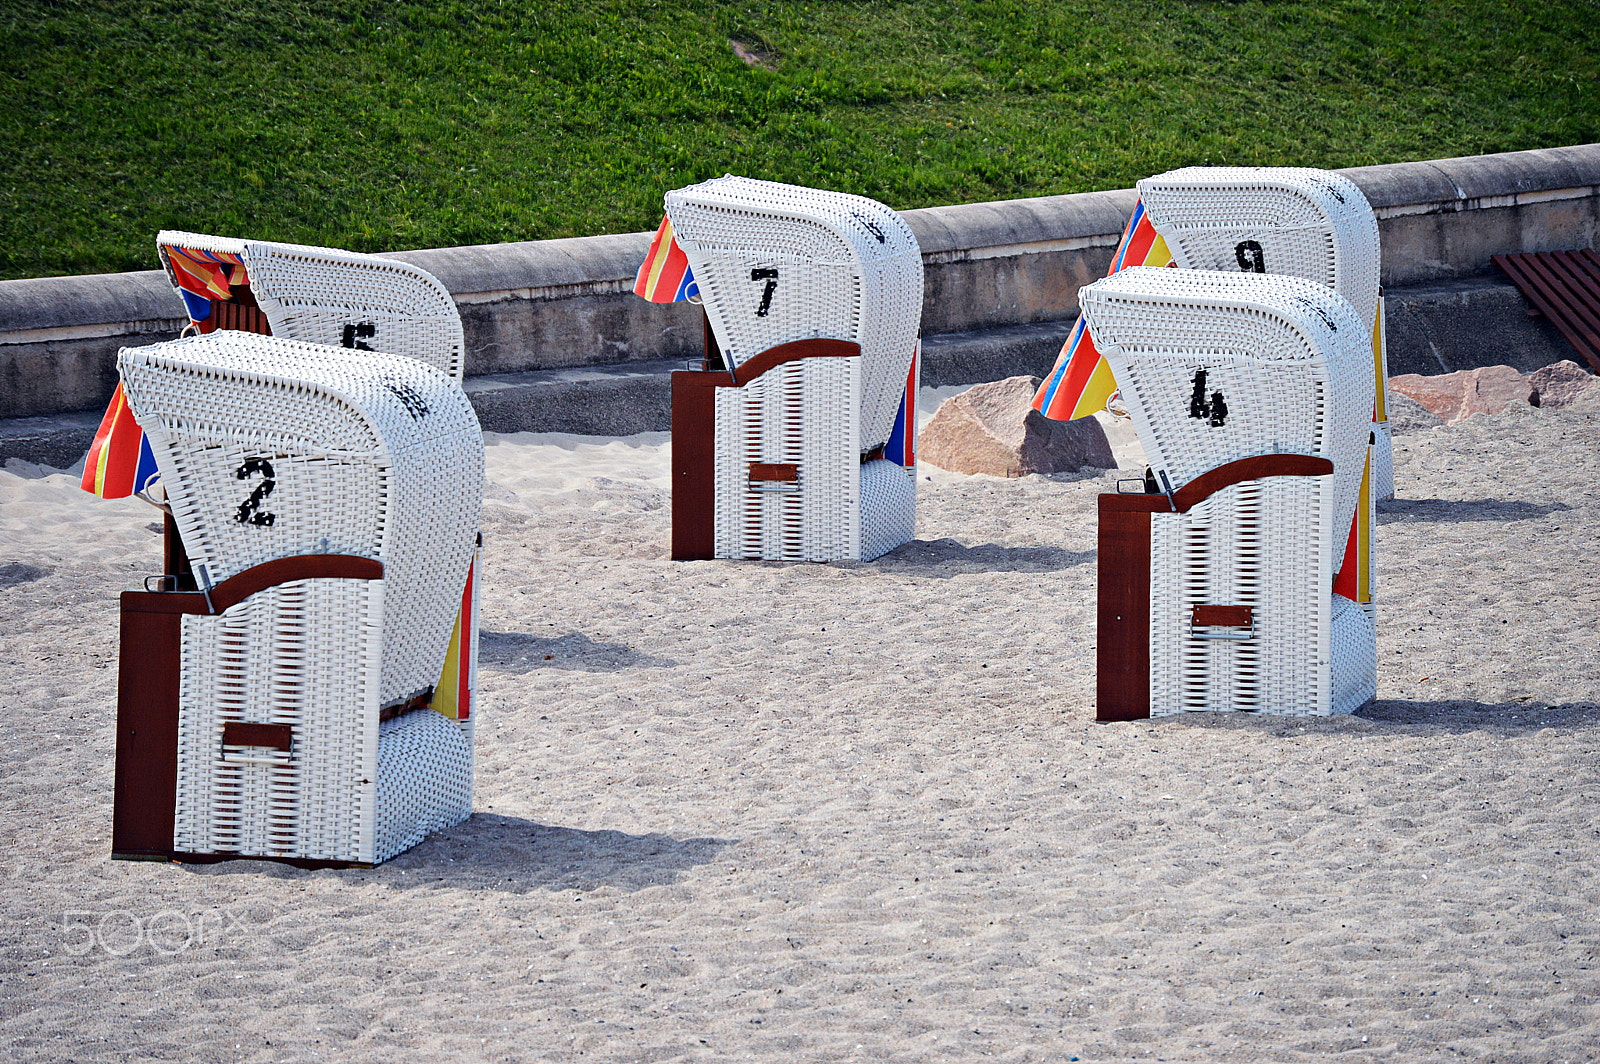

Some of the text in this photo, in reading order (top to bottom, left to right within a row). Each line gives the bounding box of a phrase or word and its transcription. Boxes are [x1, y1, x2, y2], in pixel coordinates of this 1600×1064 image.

[1234, 240, 1266, 273] 9
[751, 268, 779, 317] 7
[1188, 370, 1229, 427] 4
[234, 457, 276, 526] 2
